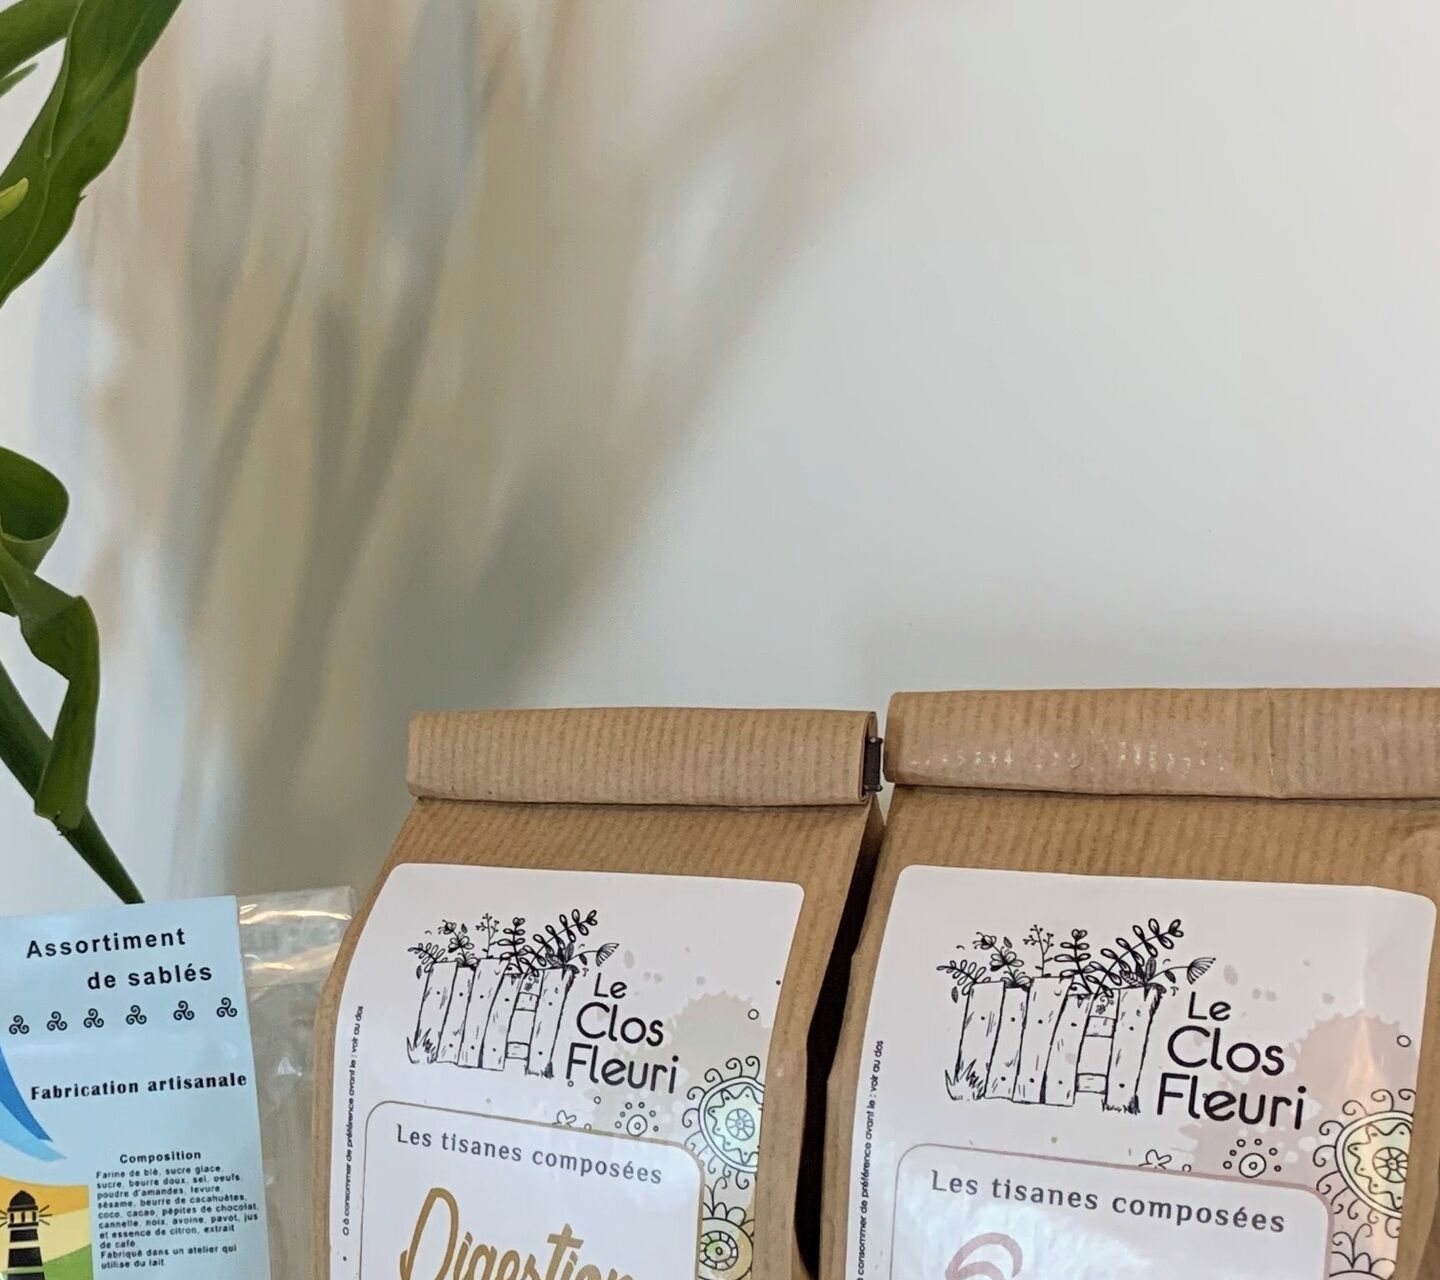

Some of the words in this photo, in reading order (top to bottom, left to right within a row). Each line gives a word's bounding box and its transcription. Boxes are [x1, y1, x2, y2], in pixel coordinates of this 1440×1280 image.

[26, 928, 186, 958] Assortiment
[88, 972, 116, 990] de
[128, 964, 212, 986] sablés
[593, 973, 628, 999] Le
[1188, 992, 1231, 1022] Le
[576, 1002, 665, 1047] Clos
[1167, 1025, 1284, 1076] Clos
[565, 1042, 679, 1094] Fleuri
[31, 1079, 139, 1100] Fabrication
[148, 1073, 247, 1092] artisanale
[1158, 1072, 1307, 1130] Fleuri
[866, 1111, 874, 1140] avant
[120, 1150, 201, 1164] Composition
[397, 1124, 432, 1148] Les
[441, 1132, 522, 1162] tisanes
[532, 1148, 662, 1185] composées
[165, 1165, 191, 1175] sucre
[97, 1191, 129, 1200] poudre
[860, 1200, 868, 1214] de
[931, 1169, 978, 1197] Les
[991, 1178, 1098, 1211] tisanes
[1112, 1191, 1285, 1234] composées
[112, 1230, 151, 1238] essence
[204, 1224, 235, 1233] extrait
[244, 1213, 258, 1222] jus
[101, 1250, 142, 1259] Fabriqué
[188, 1246, 218, 1254] atelier
[222, 1245, 237, 1254] qui
[858, 1216, 866, 1275] consommer
[101, 1261, 130, 1269] utilise
